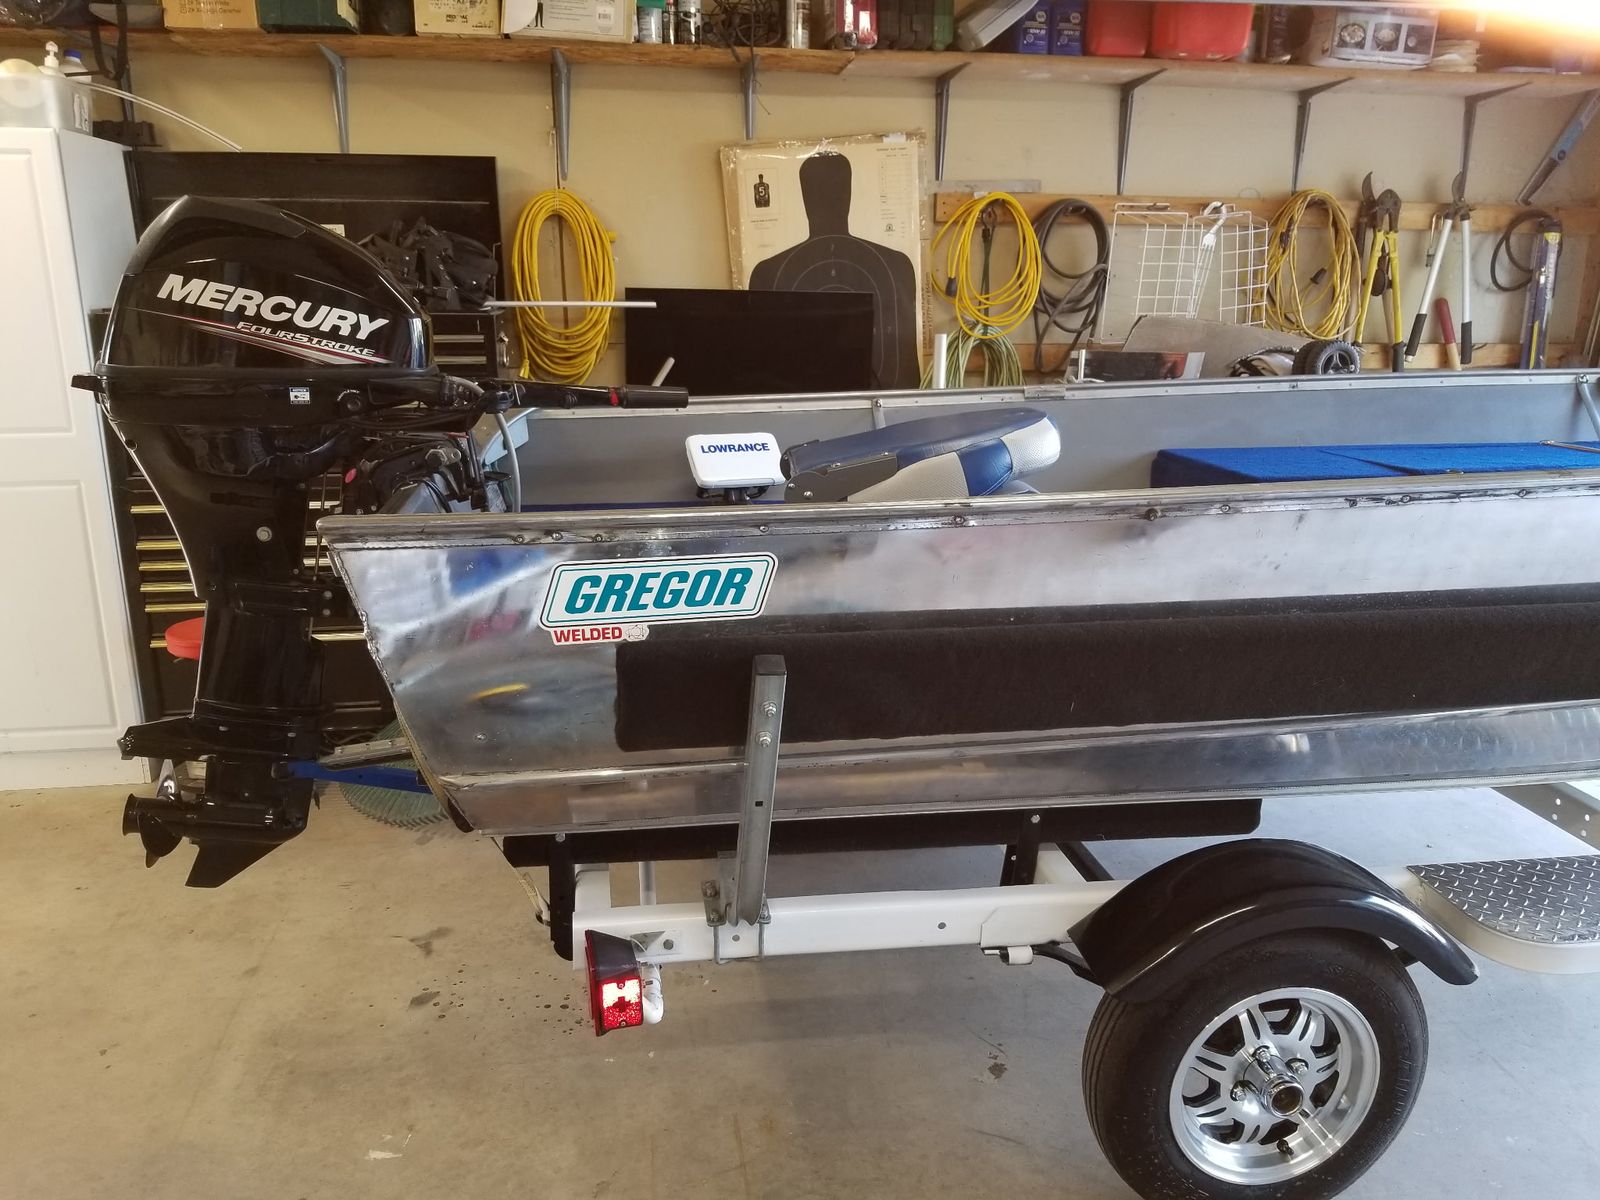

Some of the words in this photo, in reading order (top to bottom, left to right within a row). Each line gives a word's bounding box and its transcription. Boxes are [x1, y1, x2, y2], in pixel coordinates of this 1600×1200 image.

[758, 186, 765, 196] 5
[157, 273, 390, 340] MERCURY
[236, 321, 376, 357] FOURSTROKE
[700, 442, 771, 454] LOWRANCE
[565, 567, 754, 615] GREGOR
[554, 626, 623, 643] WELDED
